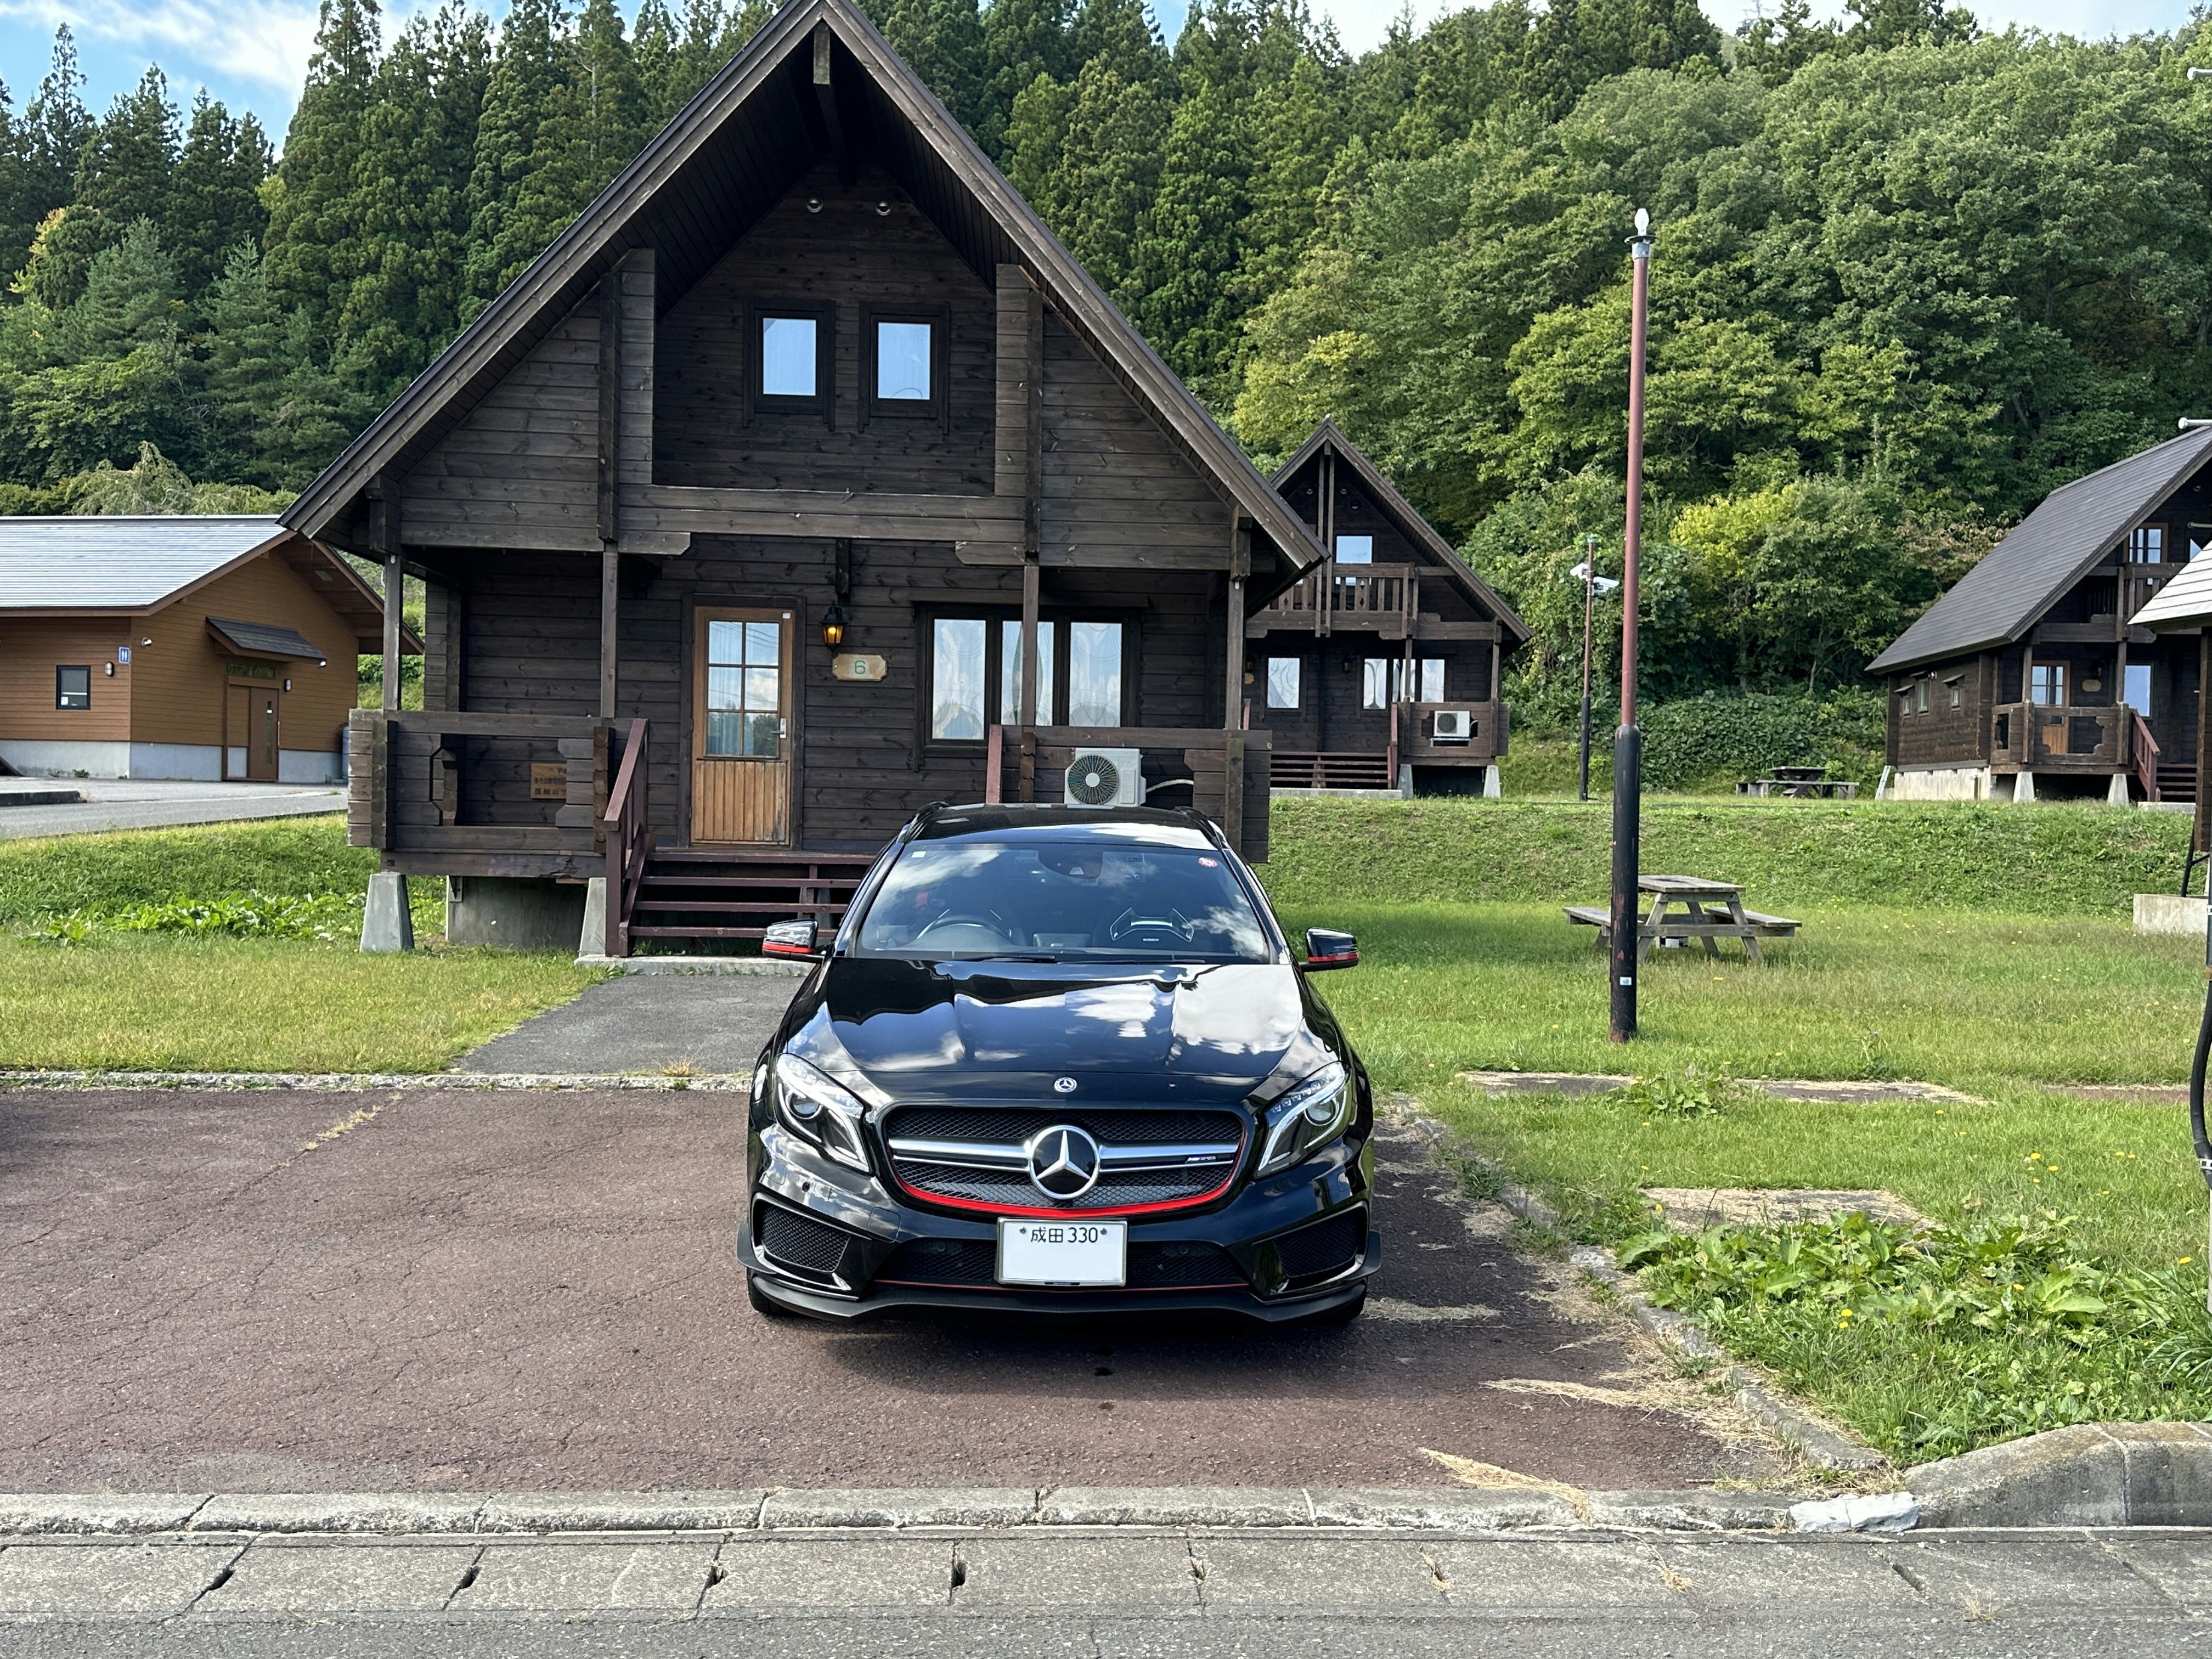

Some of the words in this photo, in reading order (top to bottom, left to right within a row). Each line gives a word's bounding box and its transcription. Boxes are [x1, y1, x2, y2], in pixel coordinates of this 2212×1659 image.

[855, 660, 866, 675] 6
[1031, 1227, 1063, 1243] 成田
[1068, 1227, 1098, 1243] 330
